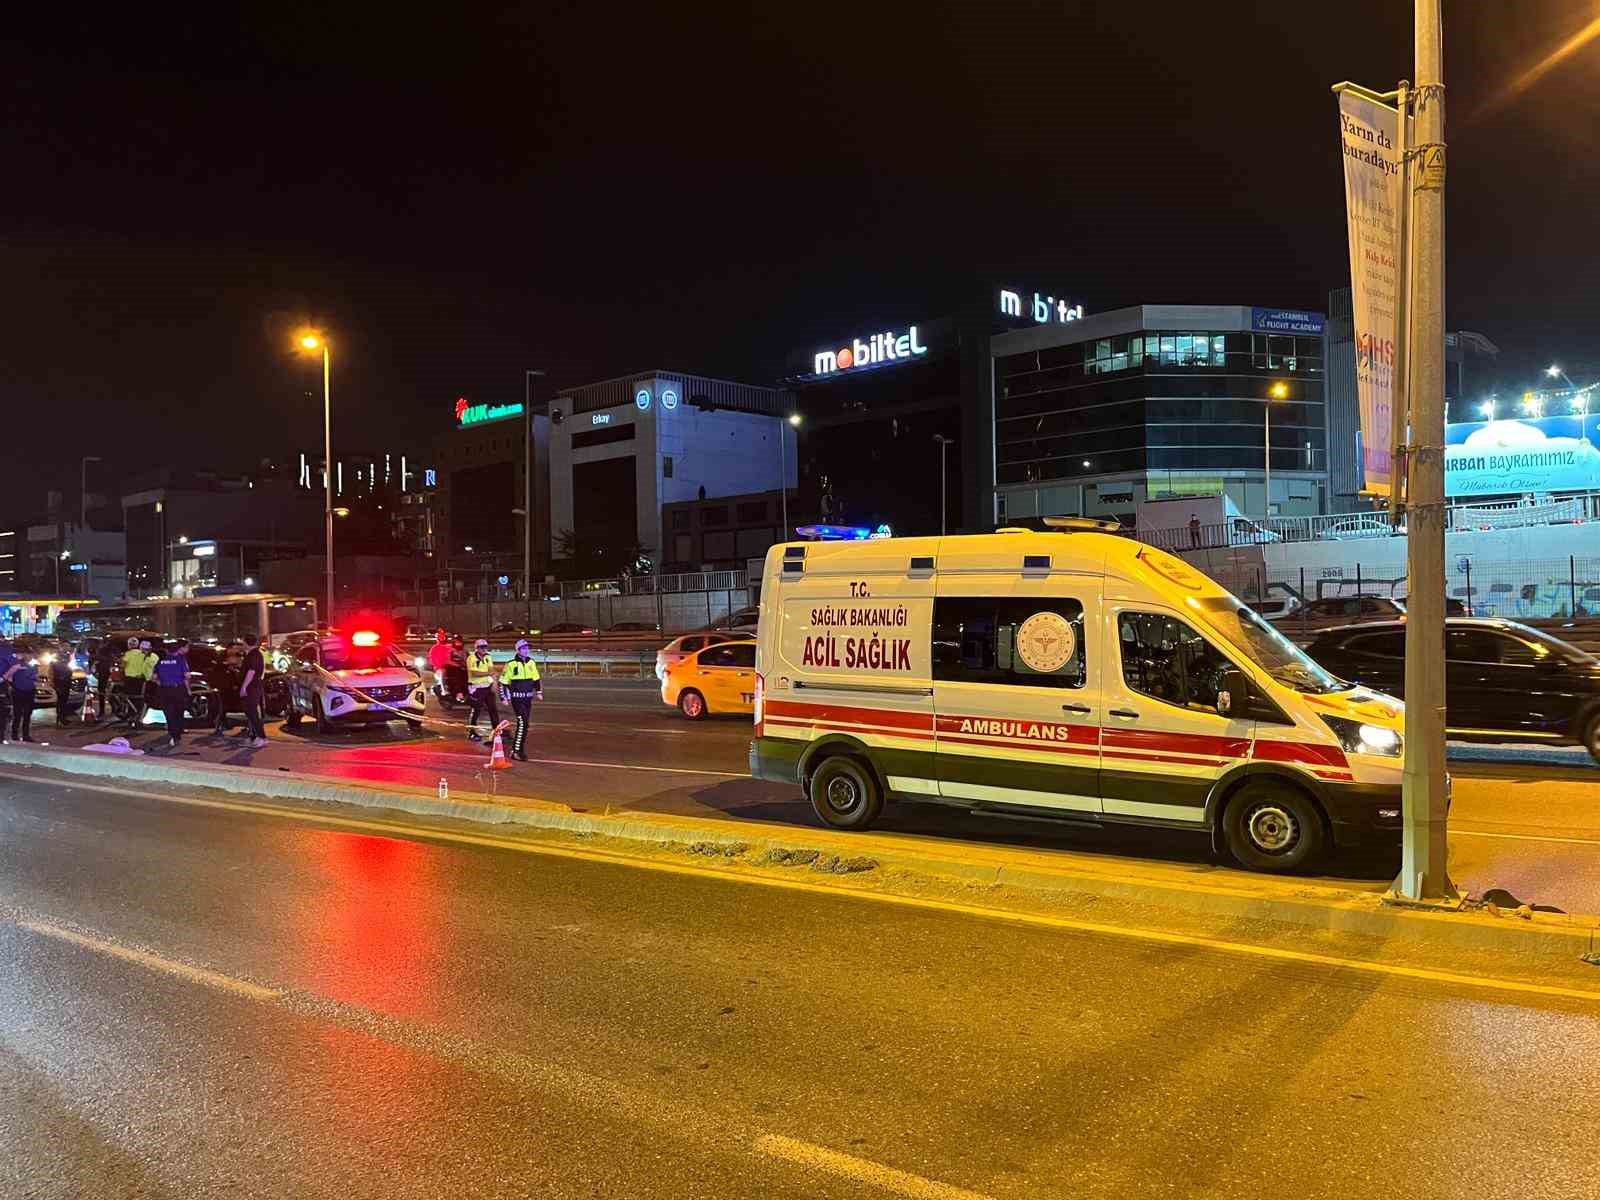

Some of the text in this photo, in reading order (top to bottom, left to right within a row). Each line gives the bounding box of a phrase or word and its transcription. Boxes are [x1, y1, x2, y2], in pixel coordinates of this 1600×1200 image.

[1341, 114, 1392, 150] Yarın da
[815, 326, 927, 375] mobiltel
[850, 582, 870, 598] T.C.
[811, 604, 908, 627] SAĞLIK BAKANLIĞI
[802, 630, 912, 671] ACİL SAĞLIK
[960, 719, 1069, 741] AMBULANS
